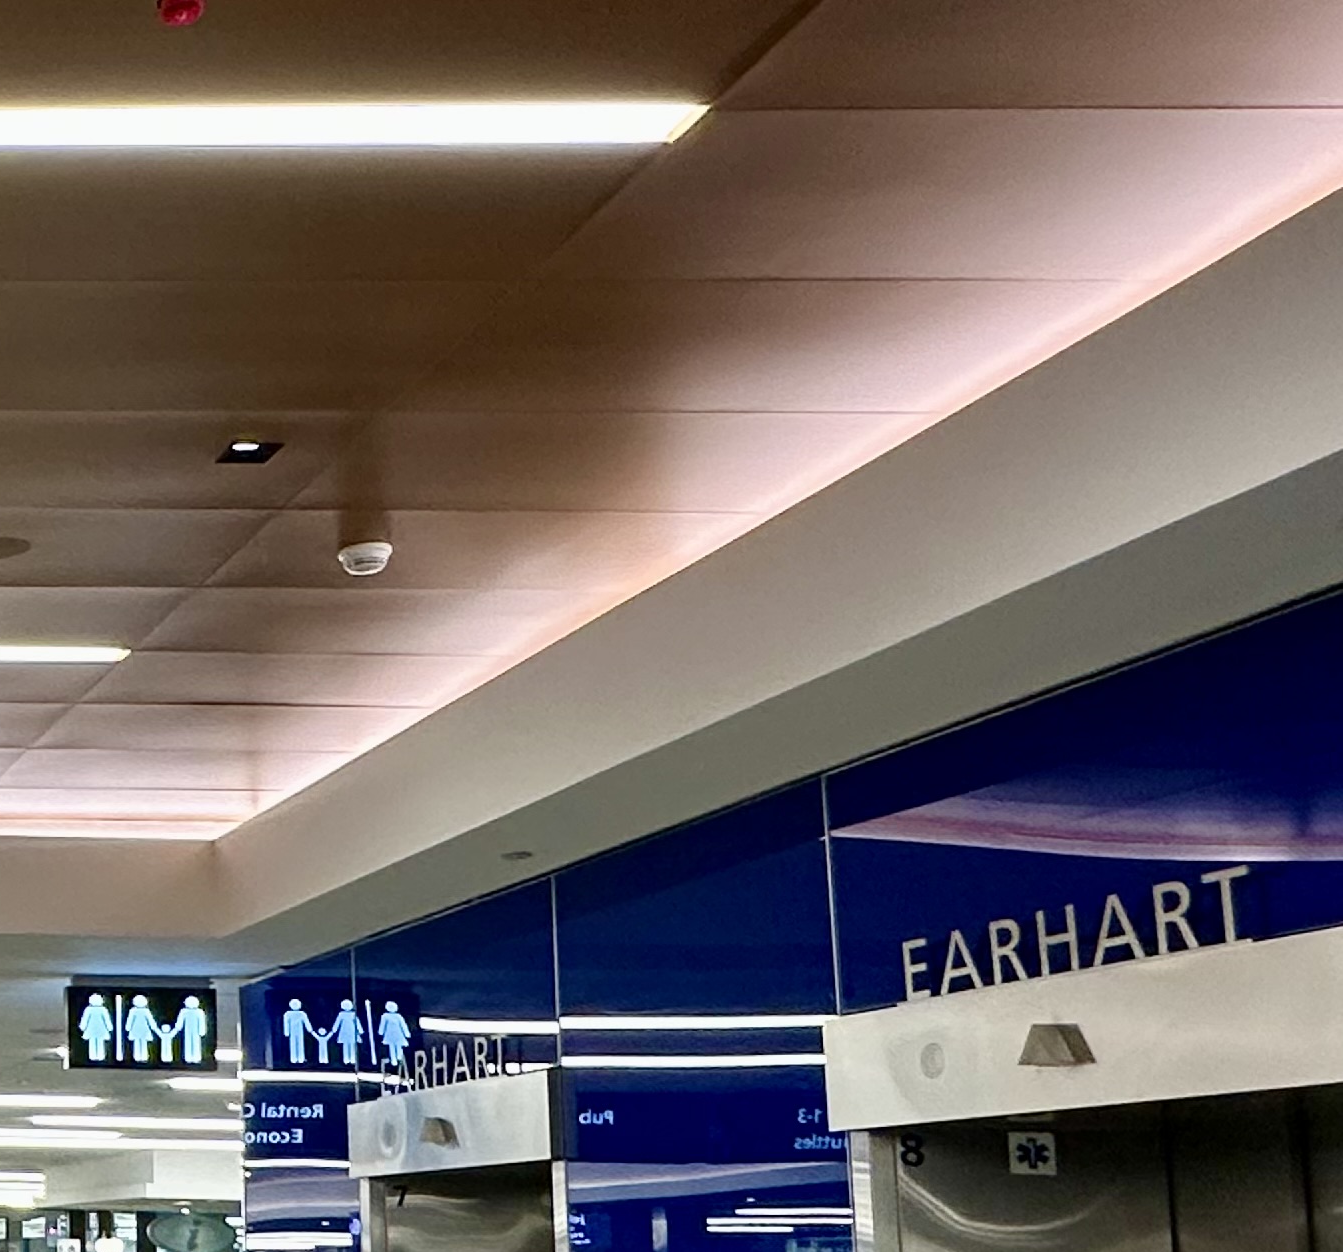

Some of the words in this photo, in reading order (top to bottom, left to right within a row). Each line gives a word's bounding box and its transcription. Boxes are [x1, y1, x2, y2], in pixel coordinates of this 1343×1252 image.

[901, 864, 1251, 1002] EARHART
[380, 1034, 508, 1097] EARHART
[900, 1132, 925, 1167] 8
[393, 1185, 409, 1208] 7
